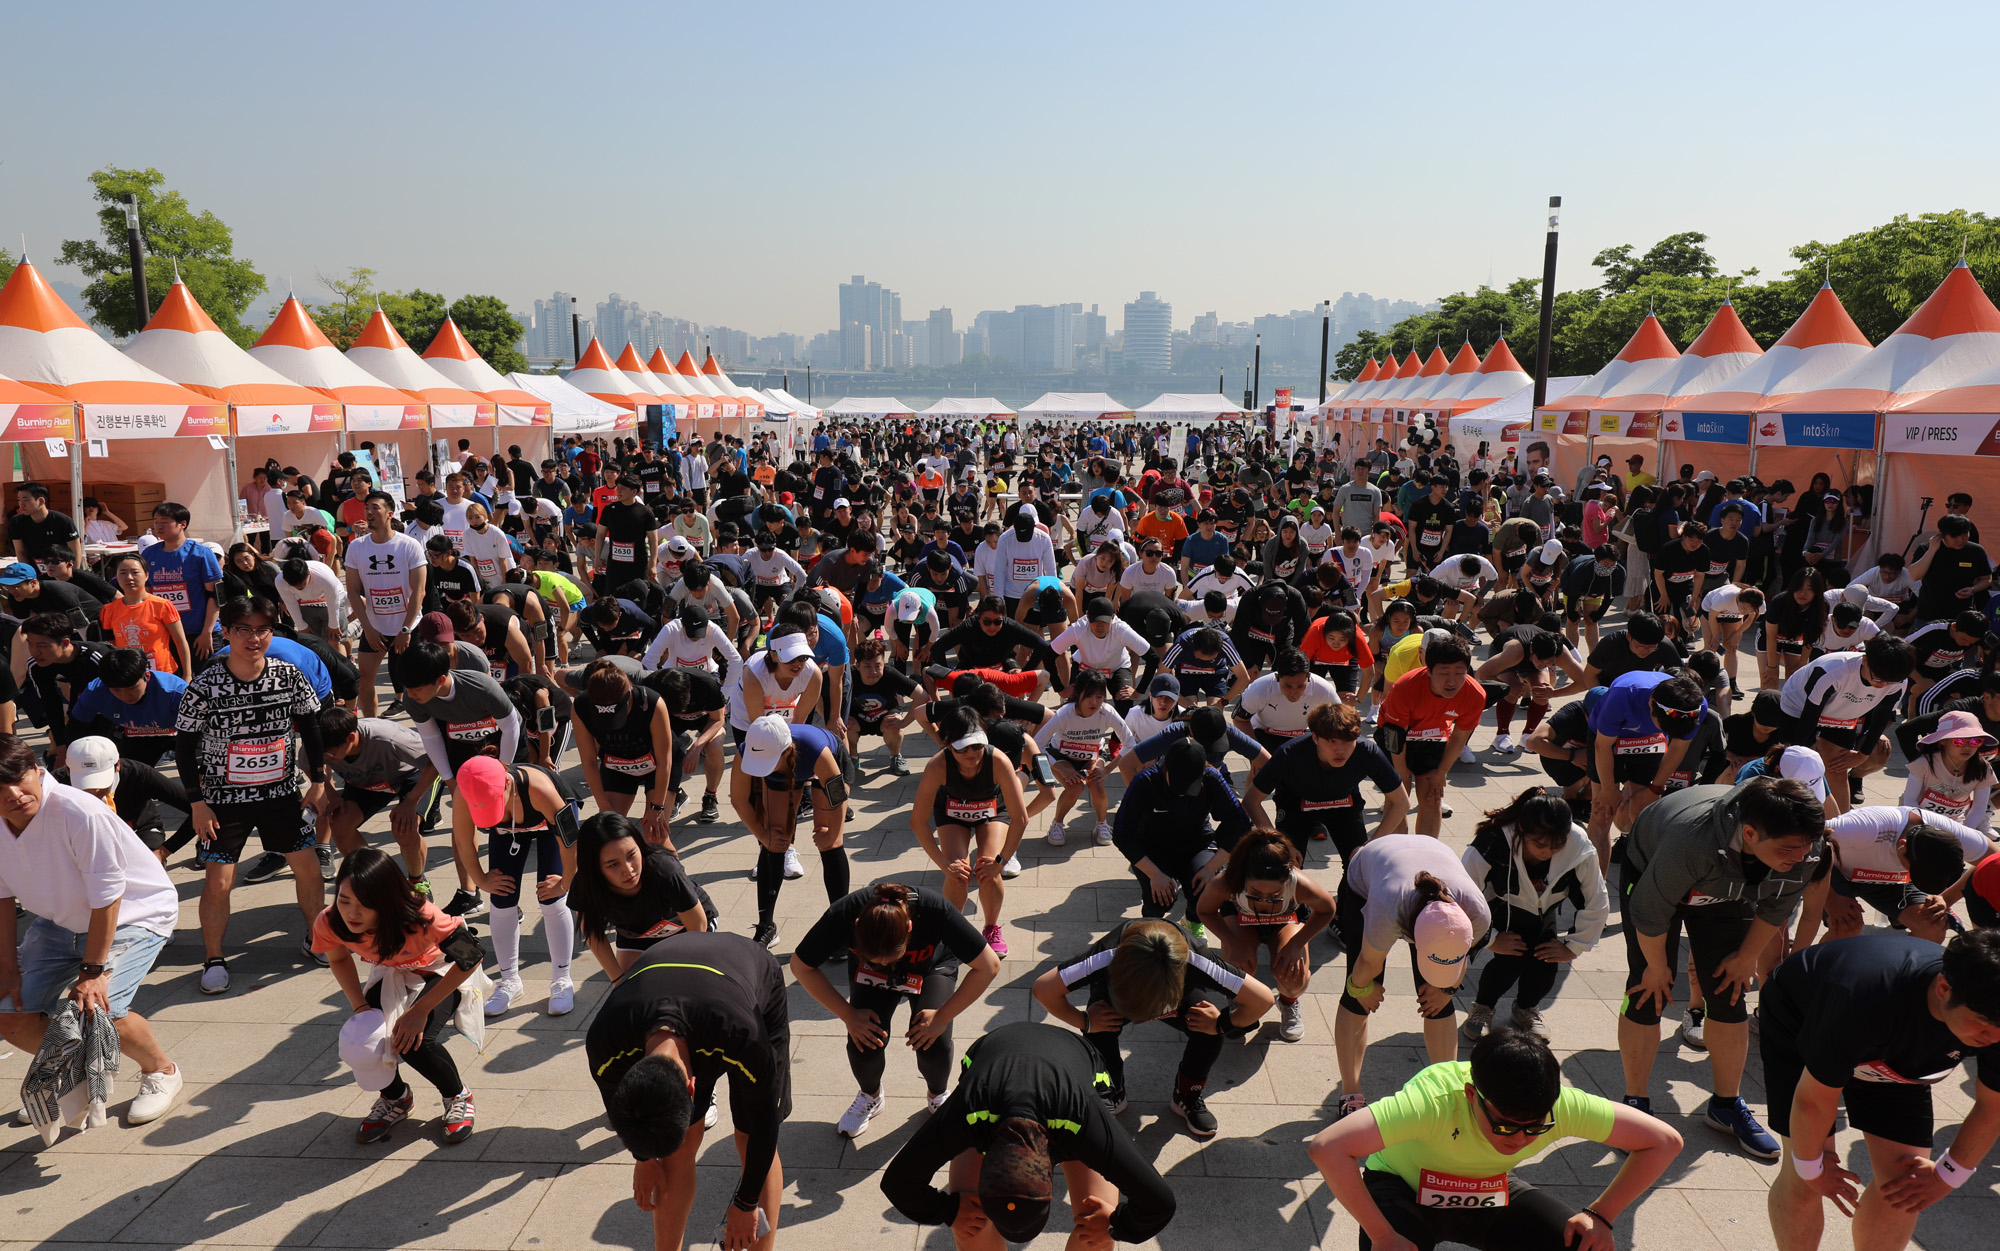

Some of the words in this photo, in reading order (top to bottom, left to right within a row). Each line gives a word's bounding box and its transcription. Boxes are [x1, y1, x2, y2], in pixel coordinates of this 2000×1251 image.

[17, 417, 53, 428] Burning
[54, 417, 71, 426] Run
[96, 415, 167, 429] 진행본부/등록확인
[187, 416, 214, 426] Burning
[215, 416, 226, 424] Run
[313, 413, 333, 422] Burning
[1632, 421, 1647, 429] Burning
[1906, 427, 1920, 440] VIP
[1928, 427, 1958, 441] PRESS
[640, 467, 659, 475] KOREA
[613, 547, 632, 555] 2630
[1016, 565, 1036, 573] 2845
[440, 581, 461, 590] FCMM
[374, 596, 401, 606] 2628
[449, 721, 477, 731] Burning
[477, 718, 493, 728] Run
[1268, 727, 1290, 736] Burning
[1062, 741, 1085, 749] Burning
[1619, 737, 1648, 747] Burning
[1649, 735, 1663, 743] Run
[232, 745, 266, 754] Burning
[267, 742, 281, 750] Run
[1622, 744, 1659, 754] 3061
[235, 755, 279, 769] 2653
[606, 756, 633, 766] Burning
[633, 754, 650, 764] Run
[949, 799, 978, 810] Burning
[979, 800, 994, 808] Run
[1928, 791, 1958, 807] Burning
[952, 810, 990, 820] 3065
[1856, 870, 1892, 881] Burning
[1893, 872, 1908, 880] Run
[1426, 1173, 1477, 1190] Burning
[1480, 1178, 1503, 1188] Run
[1430, 1194, 1496, 1208] 2806
